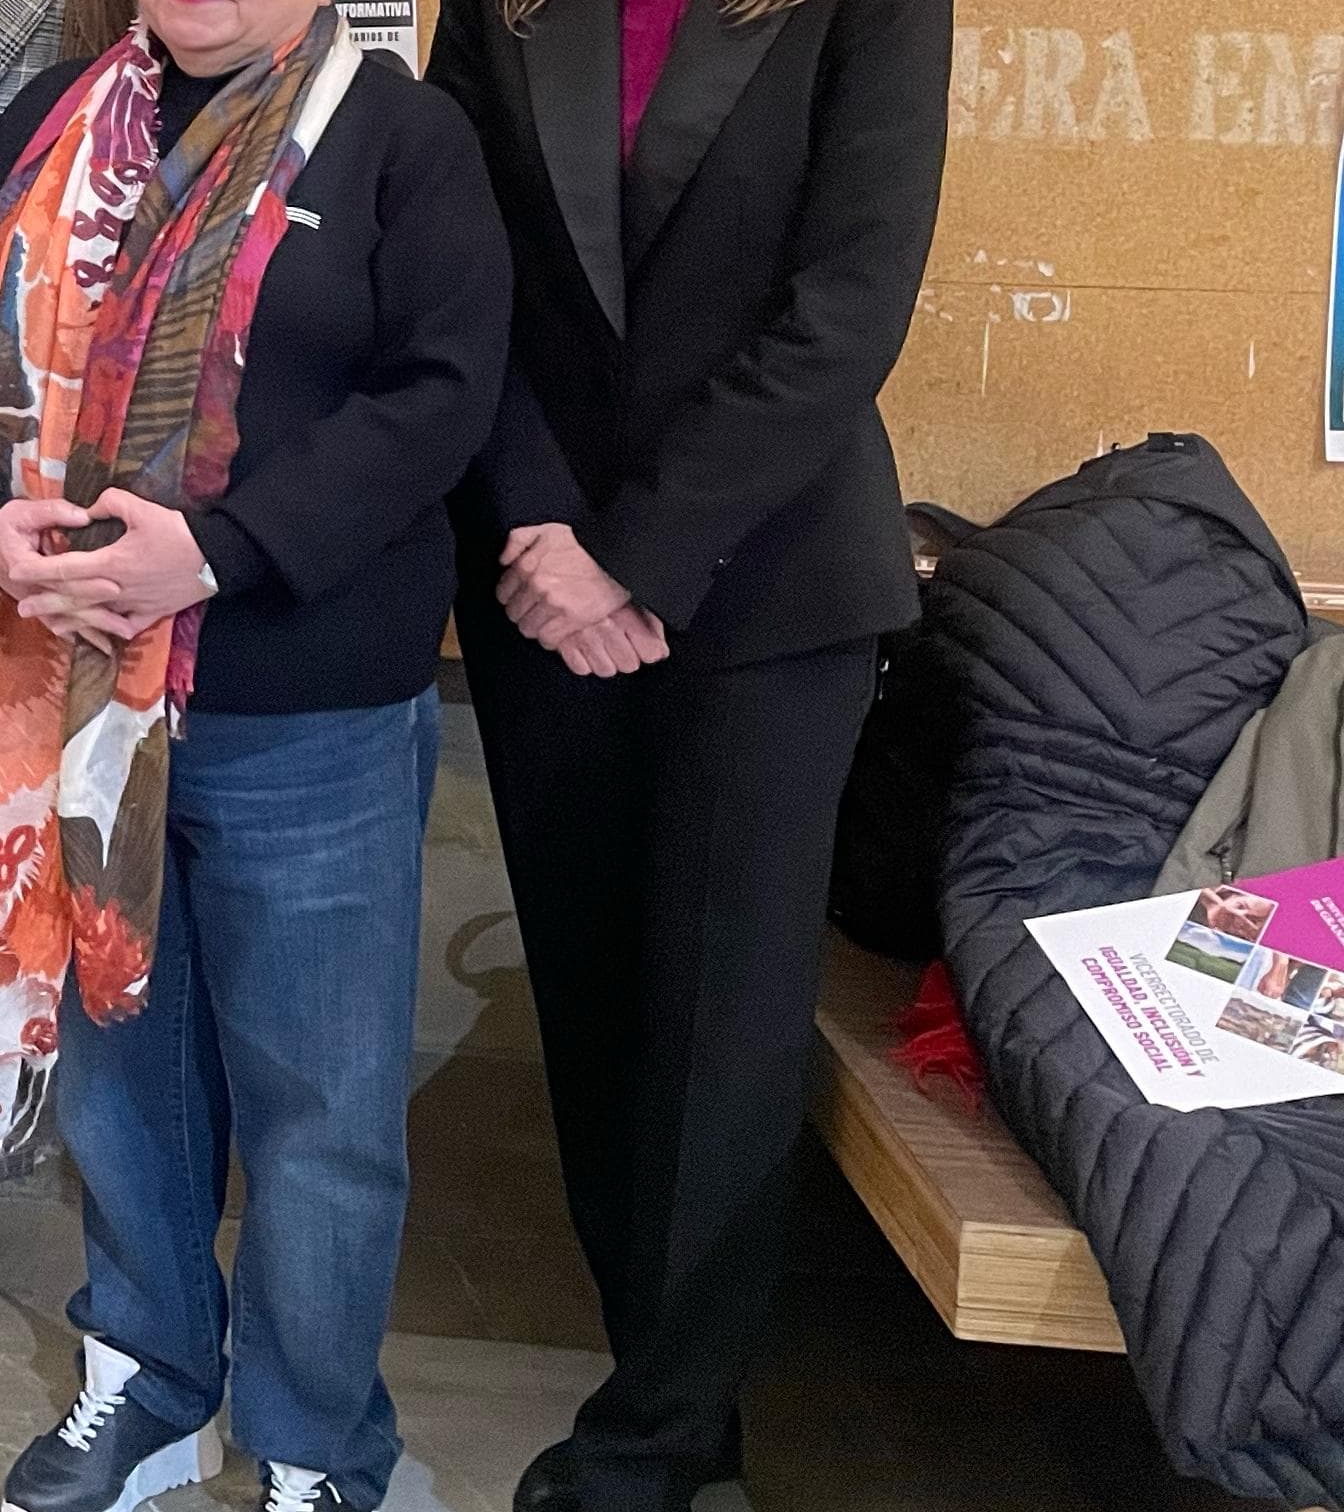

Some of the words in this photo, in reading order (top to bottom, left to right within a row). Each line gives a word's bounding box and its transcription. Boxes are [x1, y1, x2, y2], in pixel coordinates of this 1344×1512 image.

[335, 2, 410, 18] NFORMATIVA
[1082, 957, 1142, 1029] COMPROMISO
[1133, 1032, 1173, 1073] SOCIAL
[1099, 946, 1147, 1004] IGUALDAD,
[1141, 1006, 1197, 1067] INCLUSIÓN
[1130, 953, 1206, 1046] VICERRECTORADO
[1195, 1048, 1220, 1064] DE
